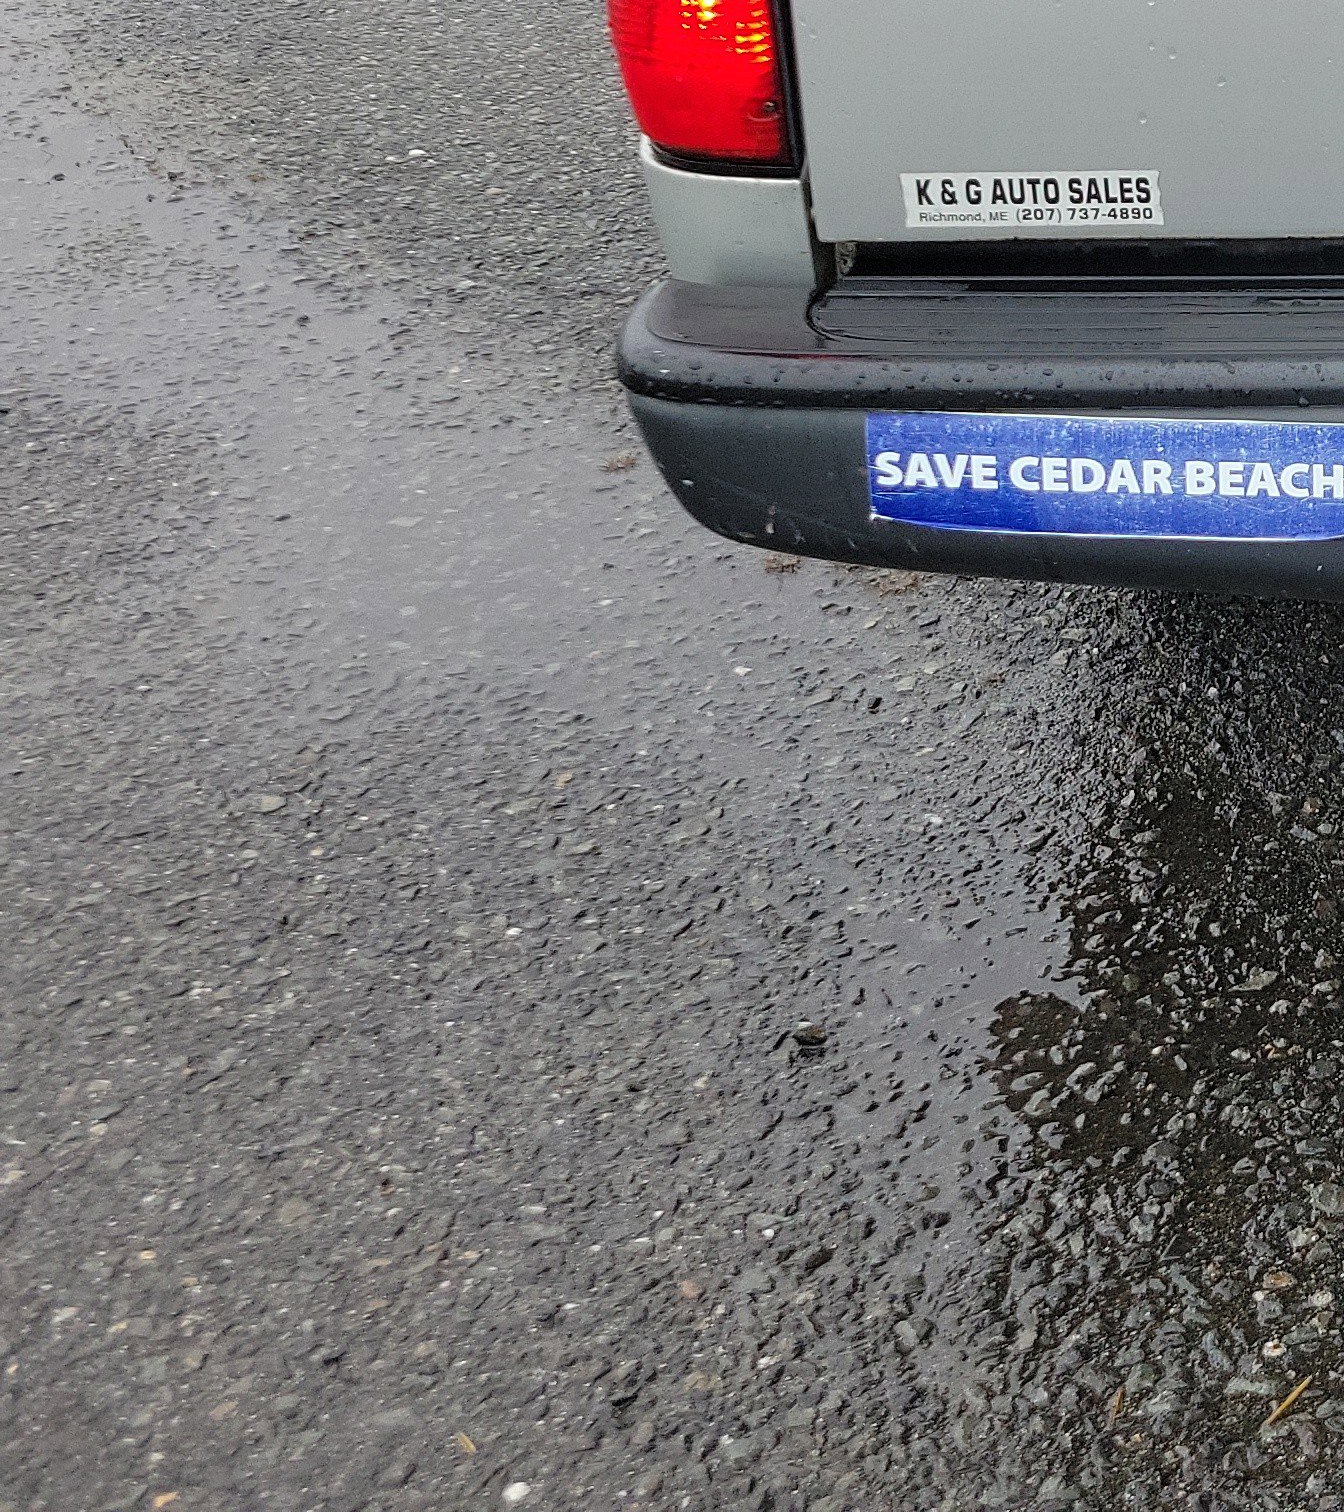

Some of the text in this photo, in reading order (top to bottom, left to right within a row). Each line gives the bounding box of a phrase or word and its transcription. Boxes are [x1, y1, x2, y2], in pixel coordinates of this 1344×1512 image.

[915, 177, 1151, 205] K & G AUTO SALES
[919, 207, 1153, 224] Richmond, ME (207) 737-4890
[875, 451, 998, 490] SAVE
[1009, 456, 1174, 495] CEDAR
